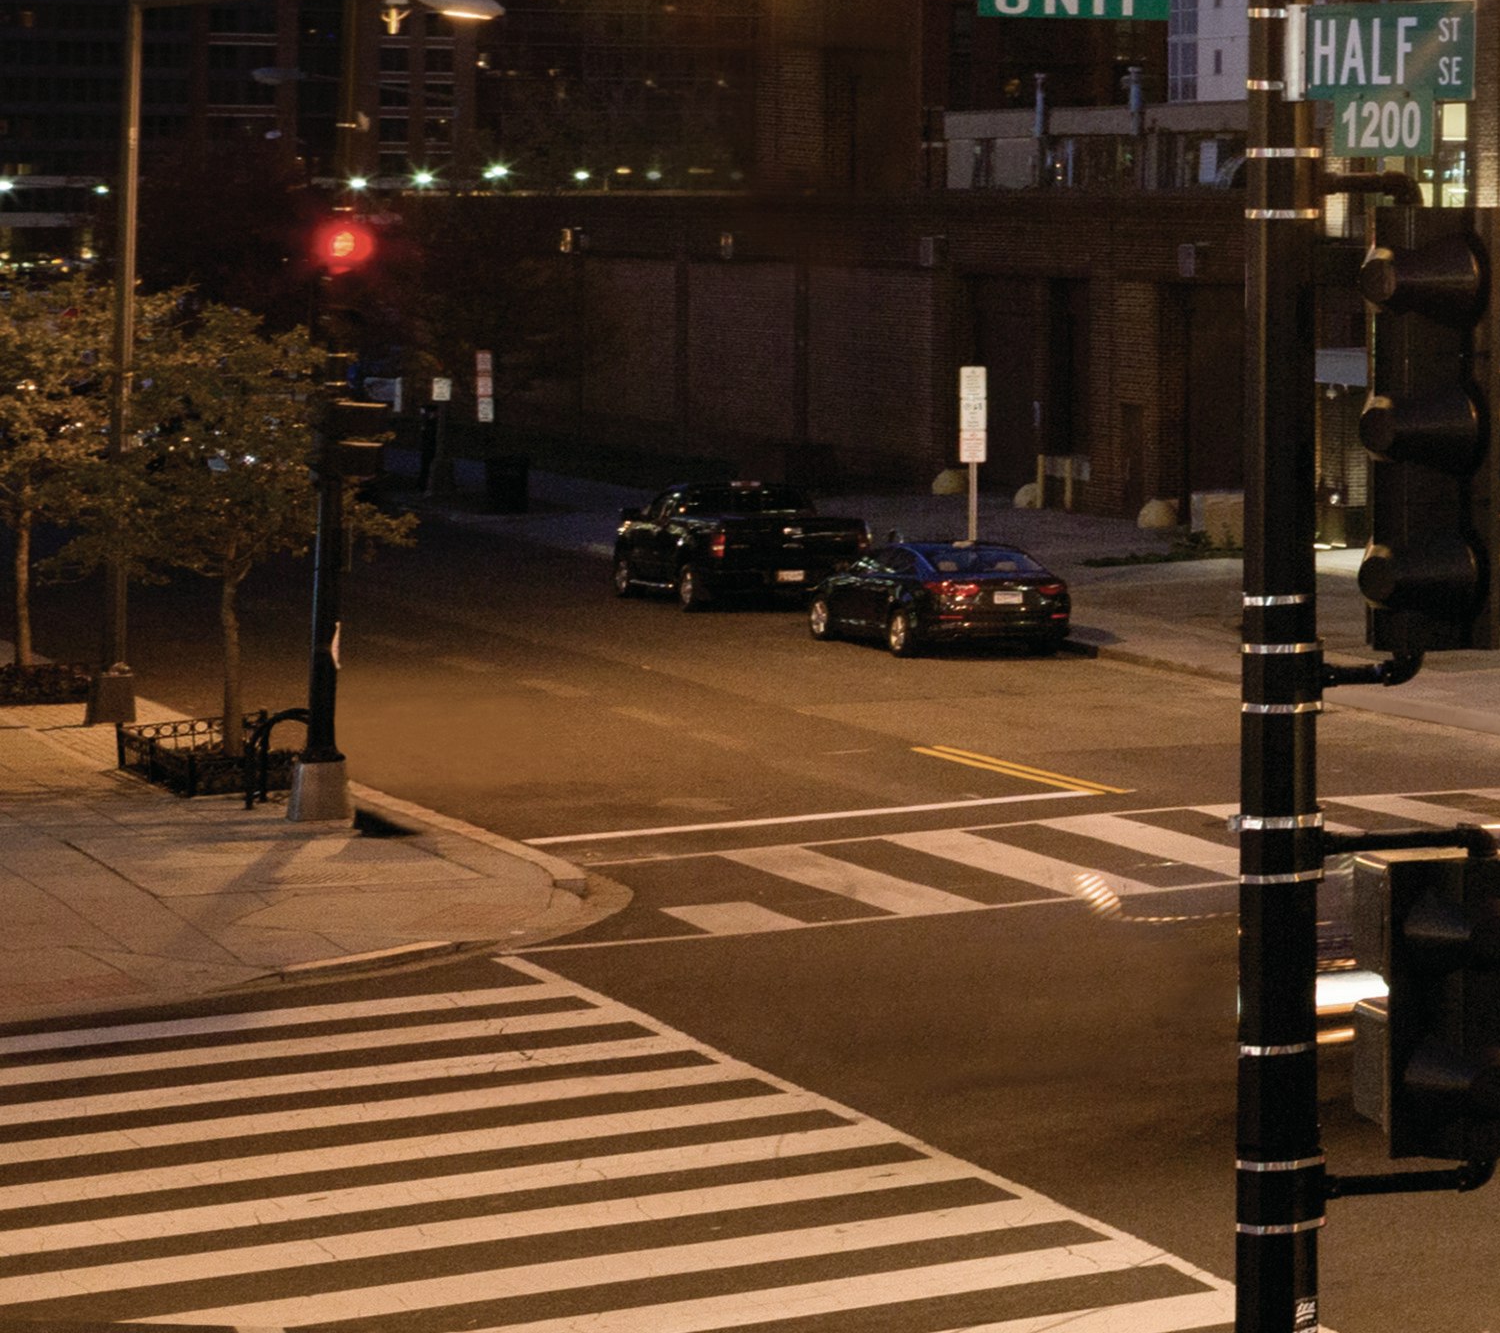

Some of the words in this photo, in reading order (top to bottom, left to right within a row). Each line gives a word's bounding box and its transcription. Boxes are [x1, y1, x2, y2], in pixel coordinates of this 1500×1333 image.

[1313, 17, 1419, 85] HALF
[1438, 17, 1461, 42] ST
[1437, 56, 1463, 85] SE
[1342, 101, 1421, 149] 1200
